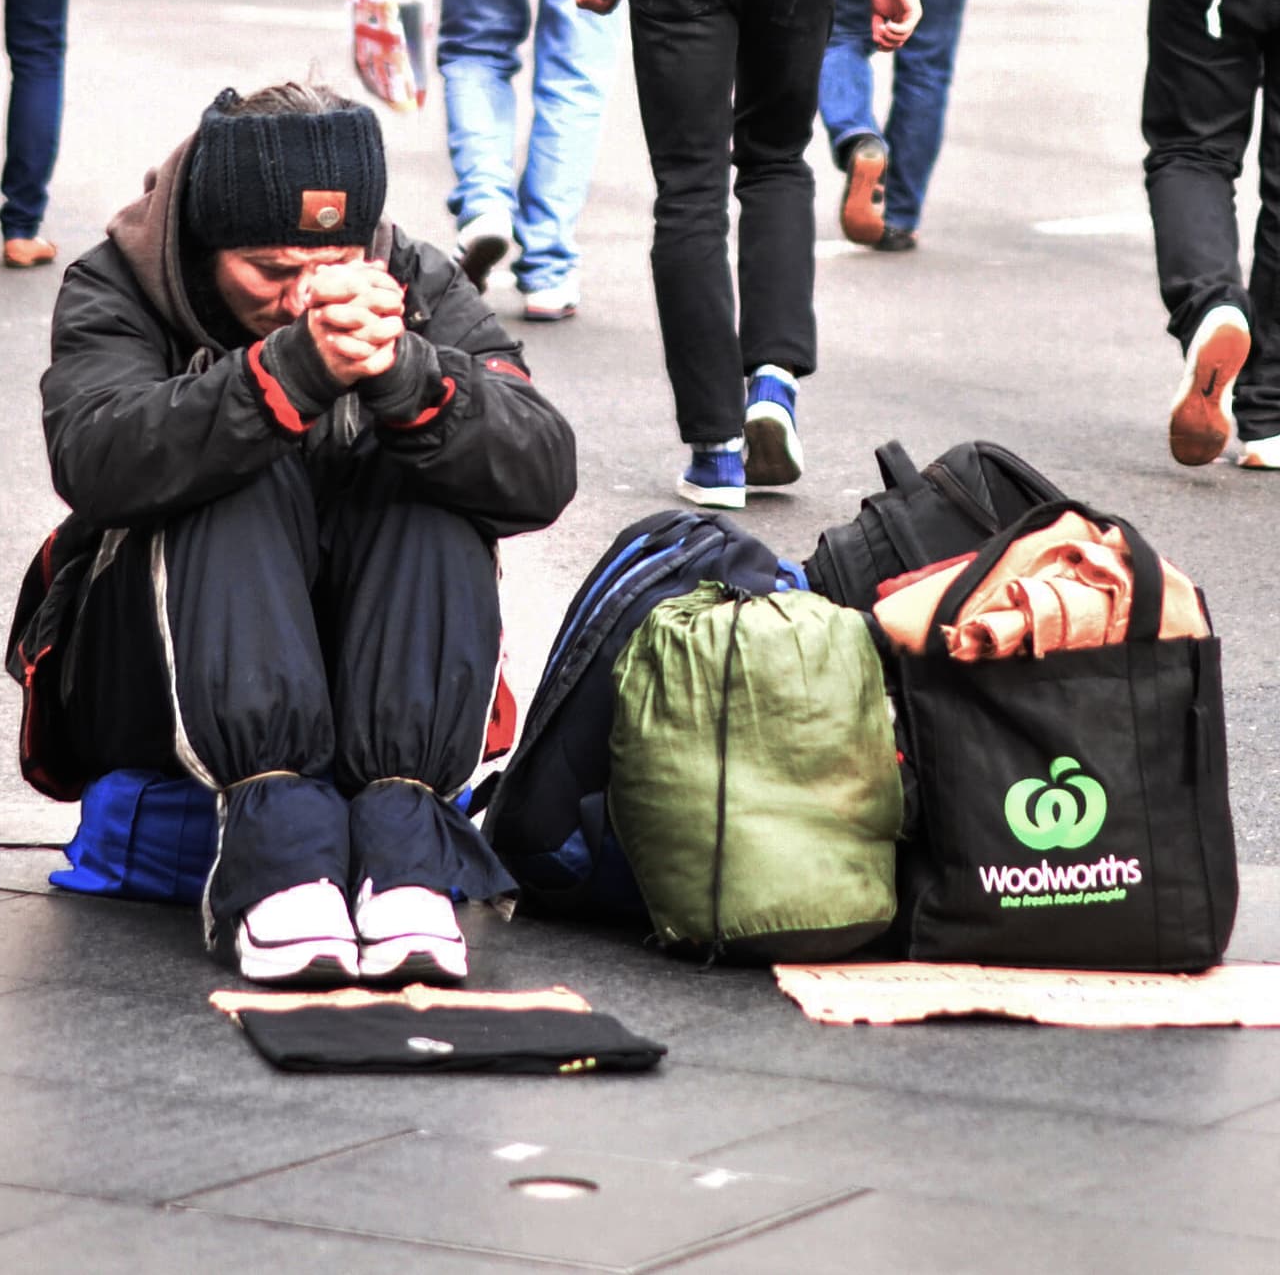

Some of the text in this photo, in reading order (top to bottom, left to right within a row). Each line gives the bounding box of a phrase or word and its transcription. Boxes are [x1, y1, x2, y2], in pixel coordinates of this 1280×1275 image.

[1000, 886, 1127, 908] the fresh food people
